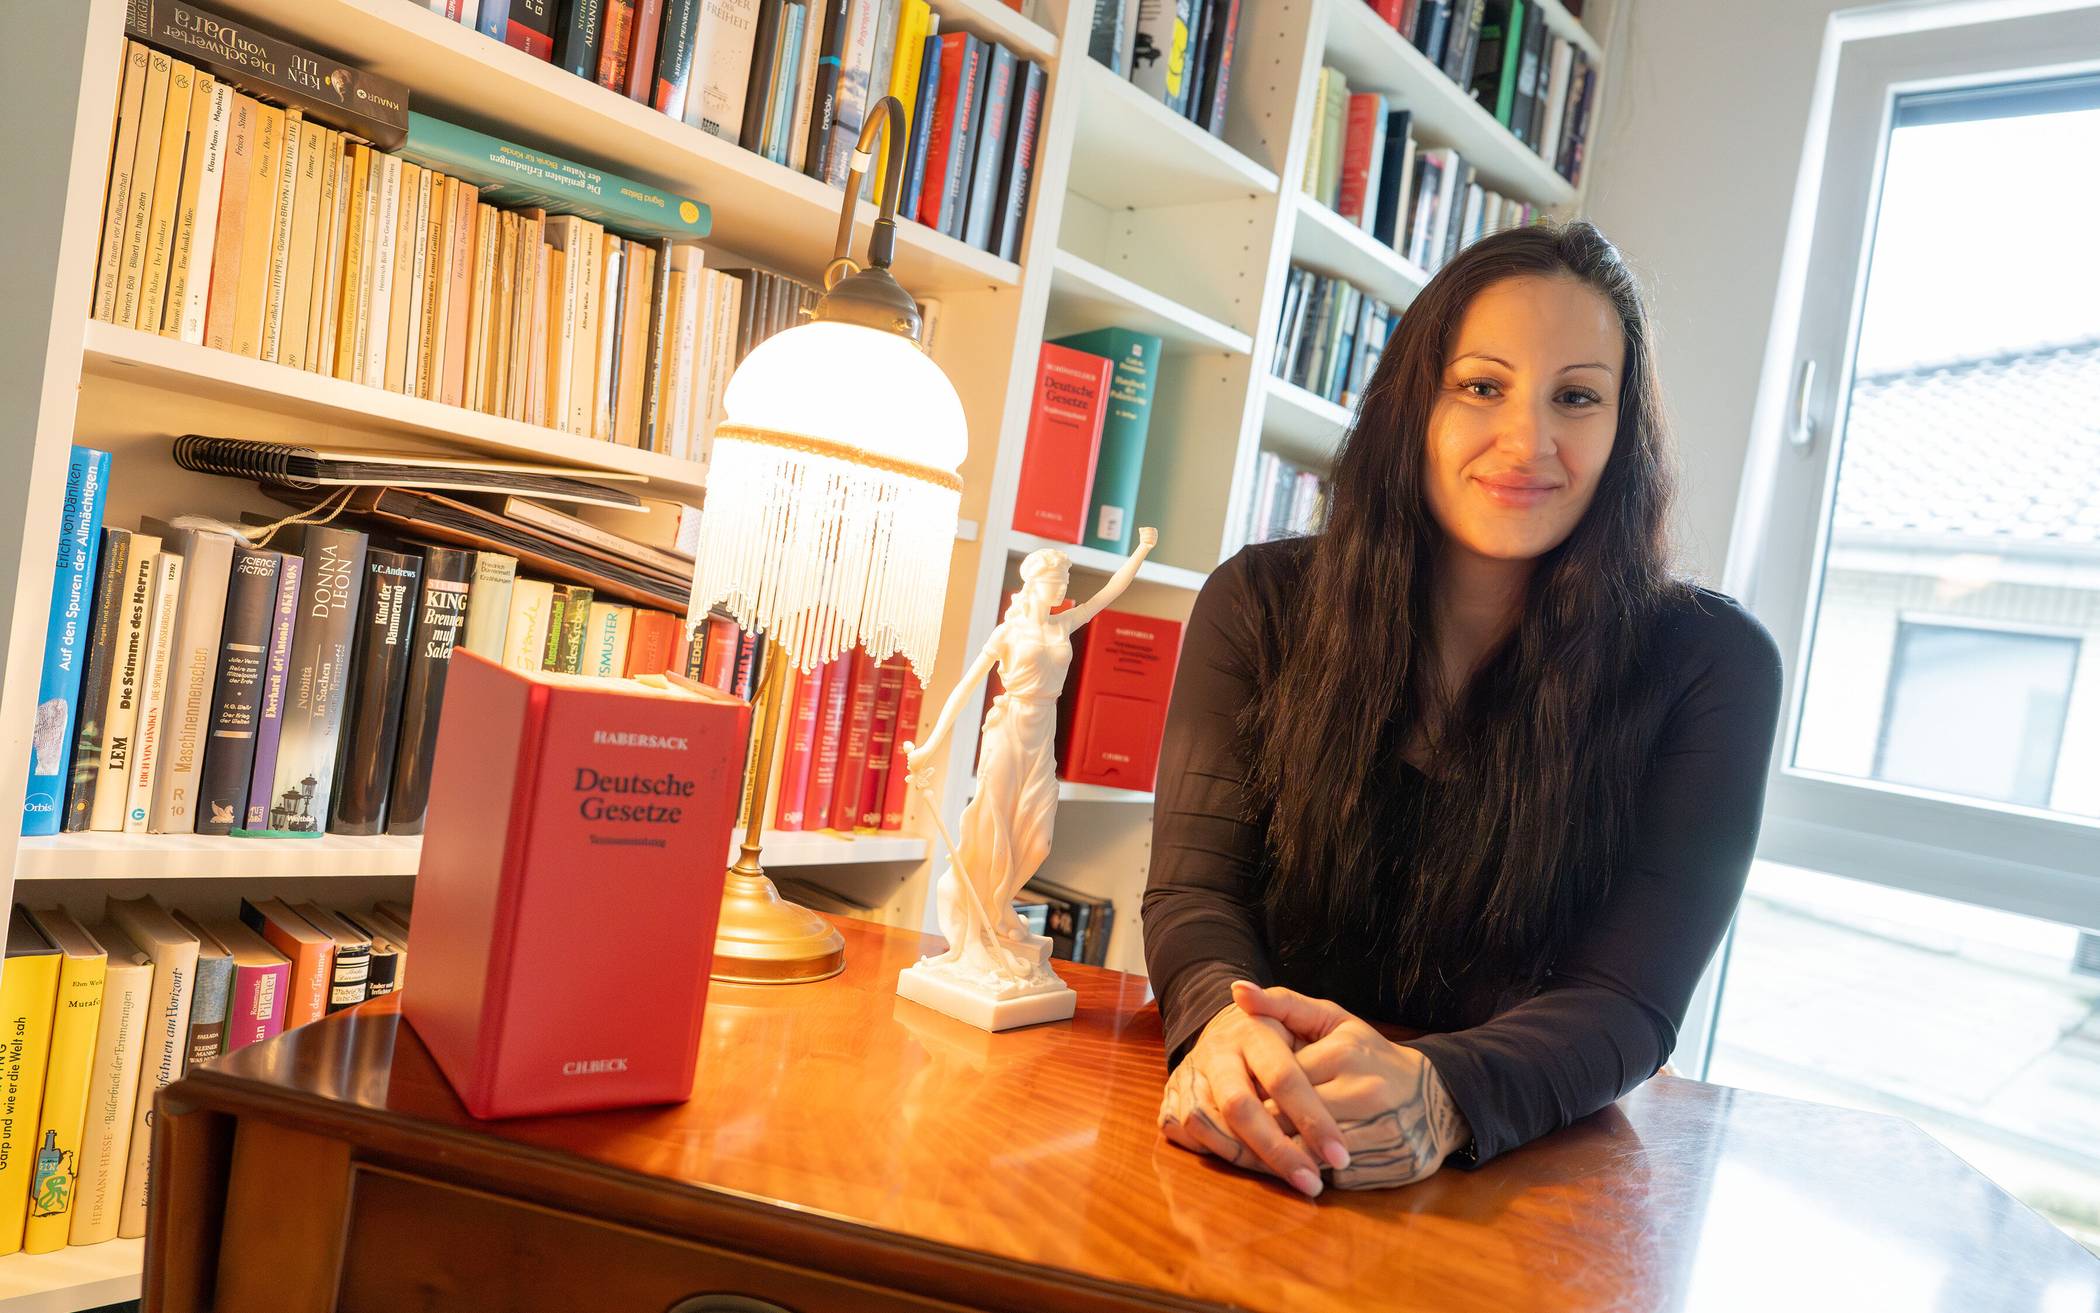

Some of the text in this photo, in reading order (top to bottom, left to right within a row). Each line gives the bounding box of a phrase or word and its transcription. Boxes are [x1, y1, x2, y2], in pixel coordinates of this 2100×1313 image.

[706, 2, 751, 30] FREIHEIT
[169, 6, 269, 59] von Dara
[161, 24, 277, 76] Die Schwerter
[288, 53, 320, 75] LIU
[284, 65, 323, 90] KEN
[366, 92, 400, 110] KNAUR
[207, 87, 224, 172] Klaus Mann Mephisto
[234, 106, 249, 156] Frisch Stiller
[264, 115, 274, 134] Staat
[288, 122, 298, 142] EHE
[262, 135, 272, 148] Der
[286, 144, 296, 158] DIE
[305, 133, 317, 178] Homer Ilias
[488, 151, 602, 194] Die genialsten Erfindungen
[561, 164, 602, 182] der Natur
[137, 191, 147, 210] zehn
[280, 188, 291, 217] BRUYN
[134, 212, 144, 228] halb
[184, 206, 194, 228] Affäre
[111, 226, 121, 238] vor
[132, 230, 142, 242] um
[180, 228, 191, 253] dunkle
[277, 228, 287, 250] Günter
[430, 223, 439, 251] Gulliver
[107, 240, 119, 267] Frauen
[129, 244, 140, 268] Billard
[148, 218, 167, 304] de Der Landarzt
[178, 253, 188, 269] Eine
[428, 253, 436, 278] Lemuel
[104, 273, 115, 287] Böll
[273, 256, 284, 287] HIPPEL
[100, 289, 113, 321] Heinrich
[121, 291, 133, 323] Heinrich
[426, 292, 434, 313] Reisen
[56, 462, 82, 568] Erich von Däniken
[58, 465, 100, 671] Auf den Spuren der Allmächtigen
[116, 542, 126, 574] Andymon
[240, 556, 277, 568] SCIENCE
[482, 561, 504, 570] Friedrich
[168, 562, 176, 580] 12392
[237, 566, 275, 577] FICTION
[310, 542, 339, 619] DONNA
[331, 558, 352, 609] LEON
[481, 566, 511, 576] Dürrenmatt
[104, 579, 114, 609] Karlheinz
[375, 583, 392, 624] Kind der
[425, 591, 468, 610] KING
[102, 610, 110, 622] und
[385, 584, 406, 645] Dämmerung
[424, 609, 464, 627] Brennen
[568, 598, 585, 644] Krebses
[99, 623, 108, 646] Angela
[118, 559, 150, 710] Die Stimme des Herrn
[265, 563, 298, 718] Eberhardt OKEANOS
[691, 632, 704, 664] EDEN
[312, 661, 332, 717] In Sachen
[138, 649, 166, 787] ERICH VON DÄNIKEN DIE SPUREN DER
[175, 646, 208, 773] Maschinenmenschen
[108, 735, 128, 770] LEM
[594, 730, 688, 750] HABERSACK
[748, 738, 760, 774] Guevara
[173, 787, 184, 800] R
[575, 768, 695, 796] Deutsche
[745, 775, 754, 791] Che
[580, 797, 682, 823] Gesetze
[308, 951, 326, 1009] der Träume
[164, 966, 185, 1037] am Horizont
[256, 974, 277, 1019] Pilcher
[12, 1016, 26, 1036] sah
[9, 1037, 23, 1062] Welt
[7, 1063, 20, 1081] die
[6, 1081, 18, 1093] er
[3, 1094, 16, 1114] wie
[91, 990, 134, 1225] HERMANN HESSE Bilderbuch der Erinnerungen
[0, 1118, 14, 1139] und
